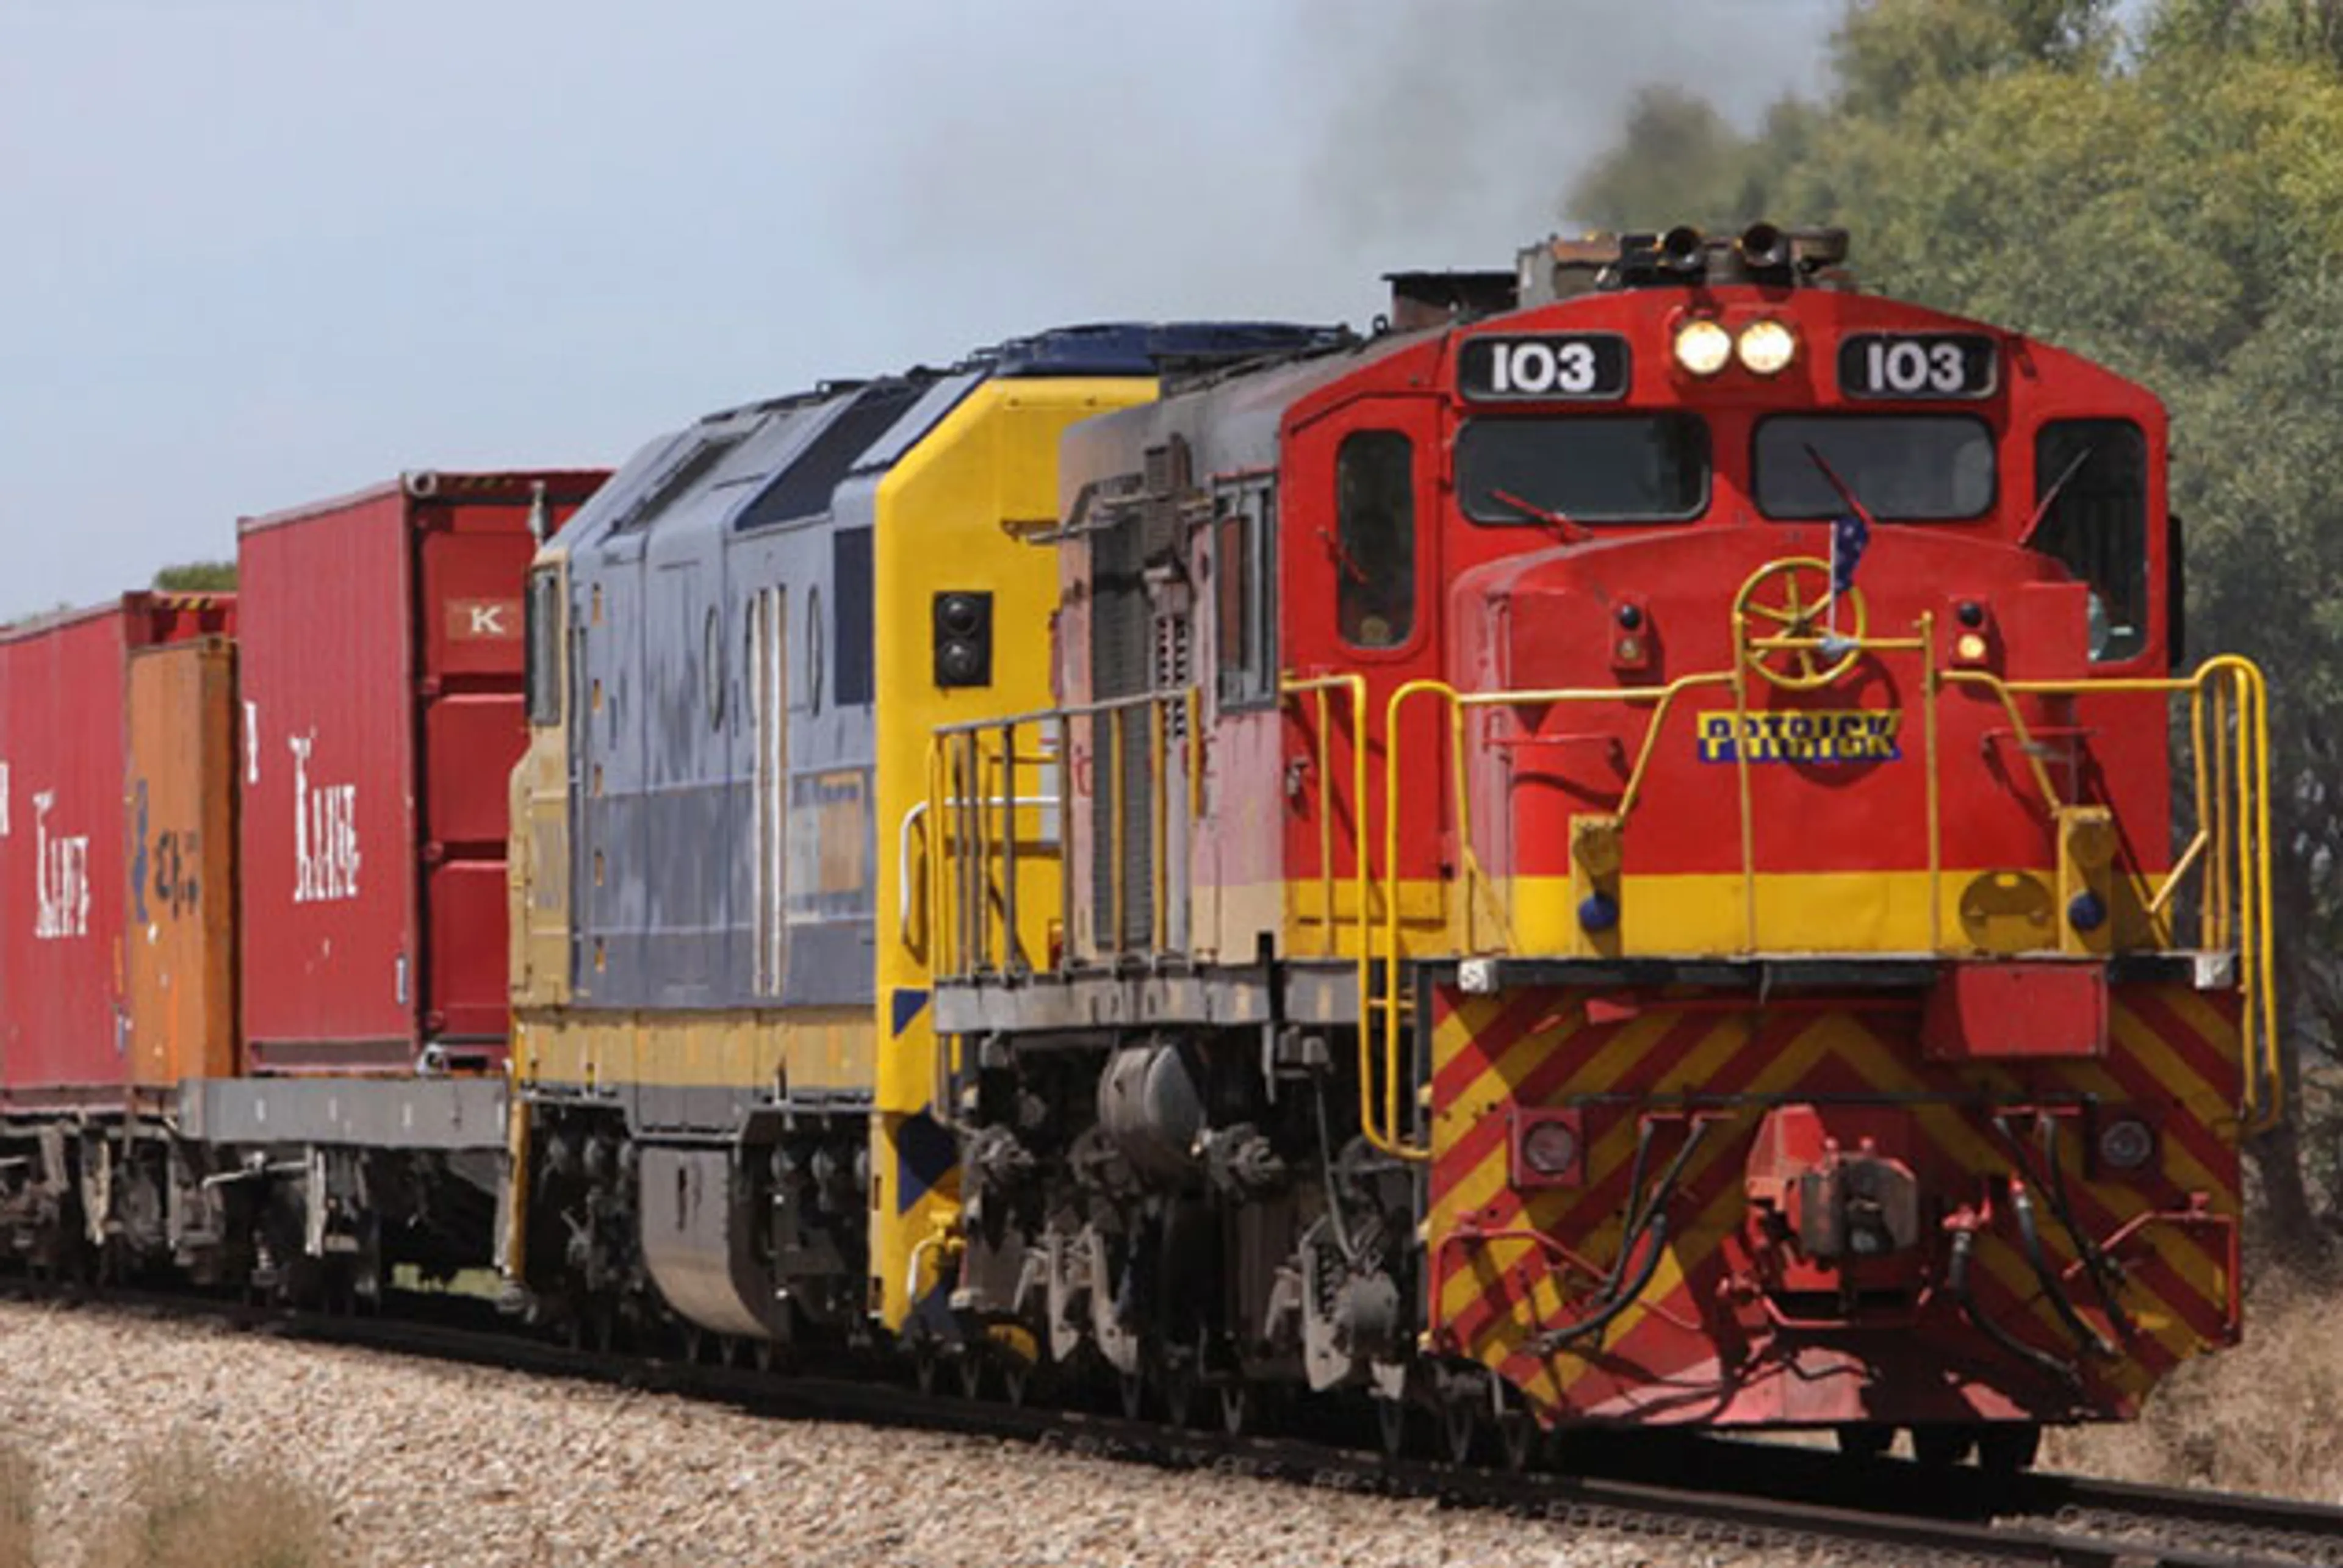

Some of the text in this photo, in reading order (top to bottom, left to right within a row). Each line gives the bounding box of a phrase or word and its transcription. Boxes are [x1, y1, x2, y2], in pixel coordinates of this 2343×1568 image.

[1492, 342, 1596, 392] 103
[1868, 341, 1964, 393] 103
[471, 605, 505, 635] K
[1704, 714, 1900, 759] PATRICK
